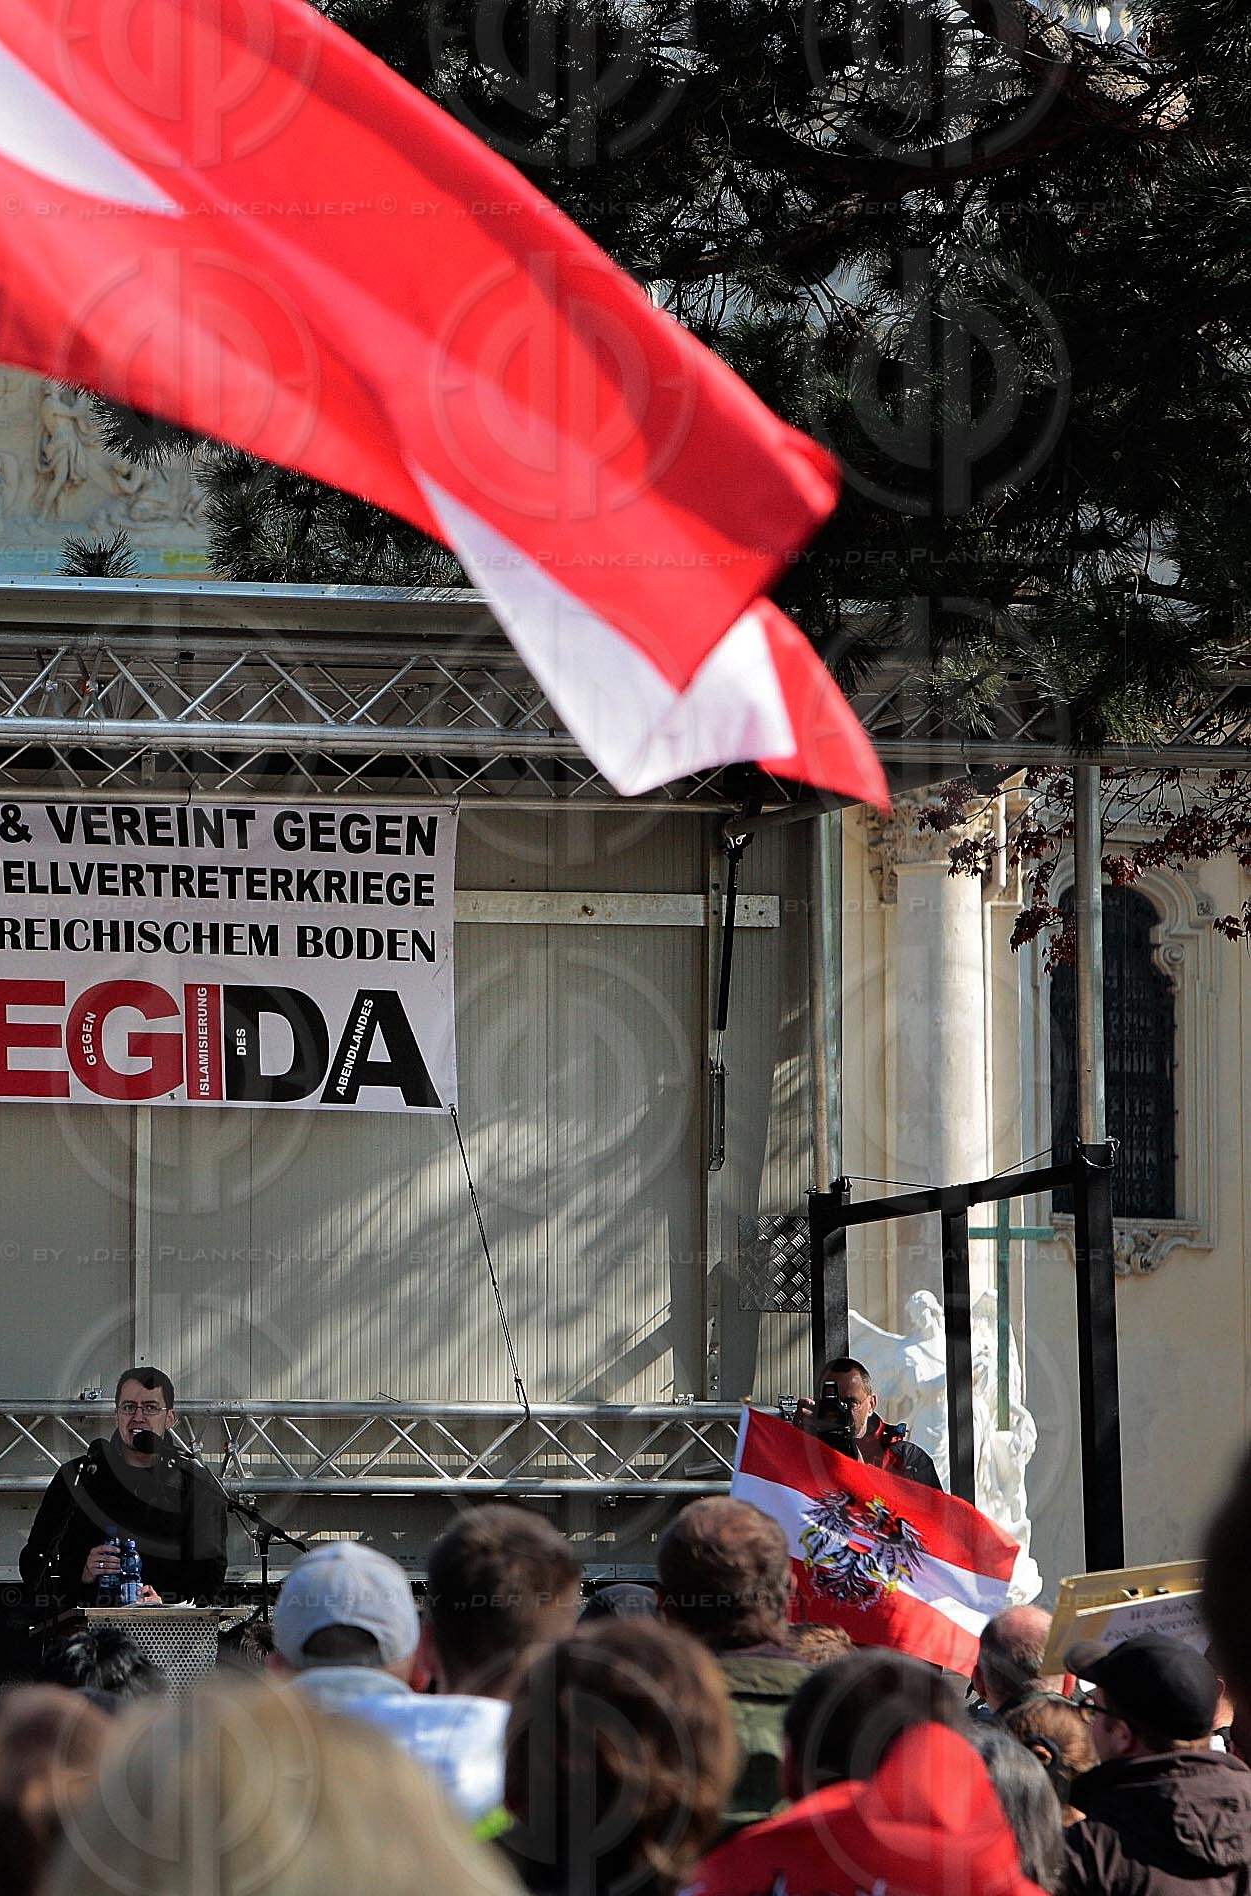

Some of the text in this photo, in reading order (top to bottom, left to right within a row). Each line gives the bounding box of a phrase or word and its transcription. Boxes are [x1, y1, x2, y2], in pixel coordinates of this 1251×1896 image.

[46, 805, 256, 849] VEREINT
[273, 811, 439, 857] GEGEN
[296, 925, 436, 963] BODEN
[80, 1010, 99, 1067] GEGEN
[199, 986, 210, 1097] ISLAMISIERUNG
[235, 1028, 247, 1056] DES
[335, 998, 375, 1097] ABENDLANDES
